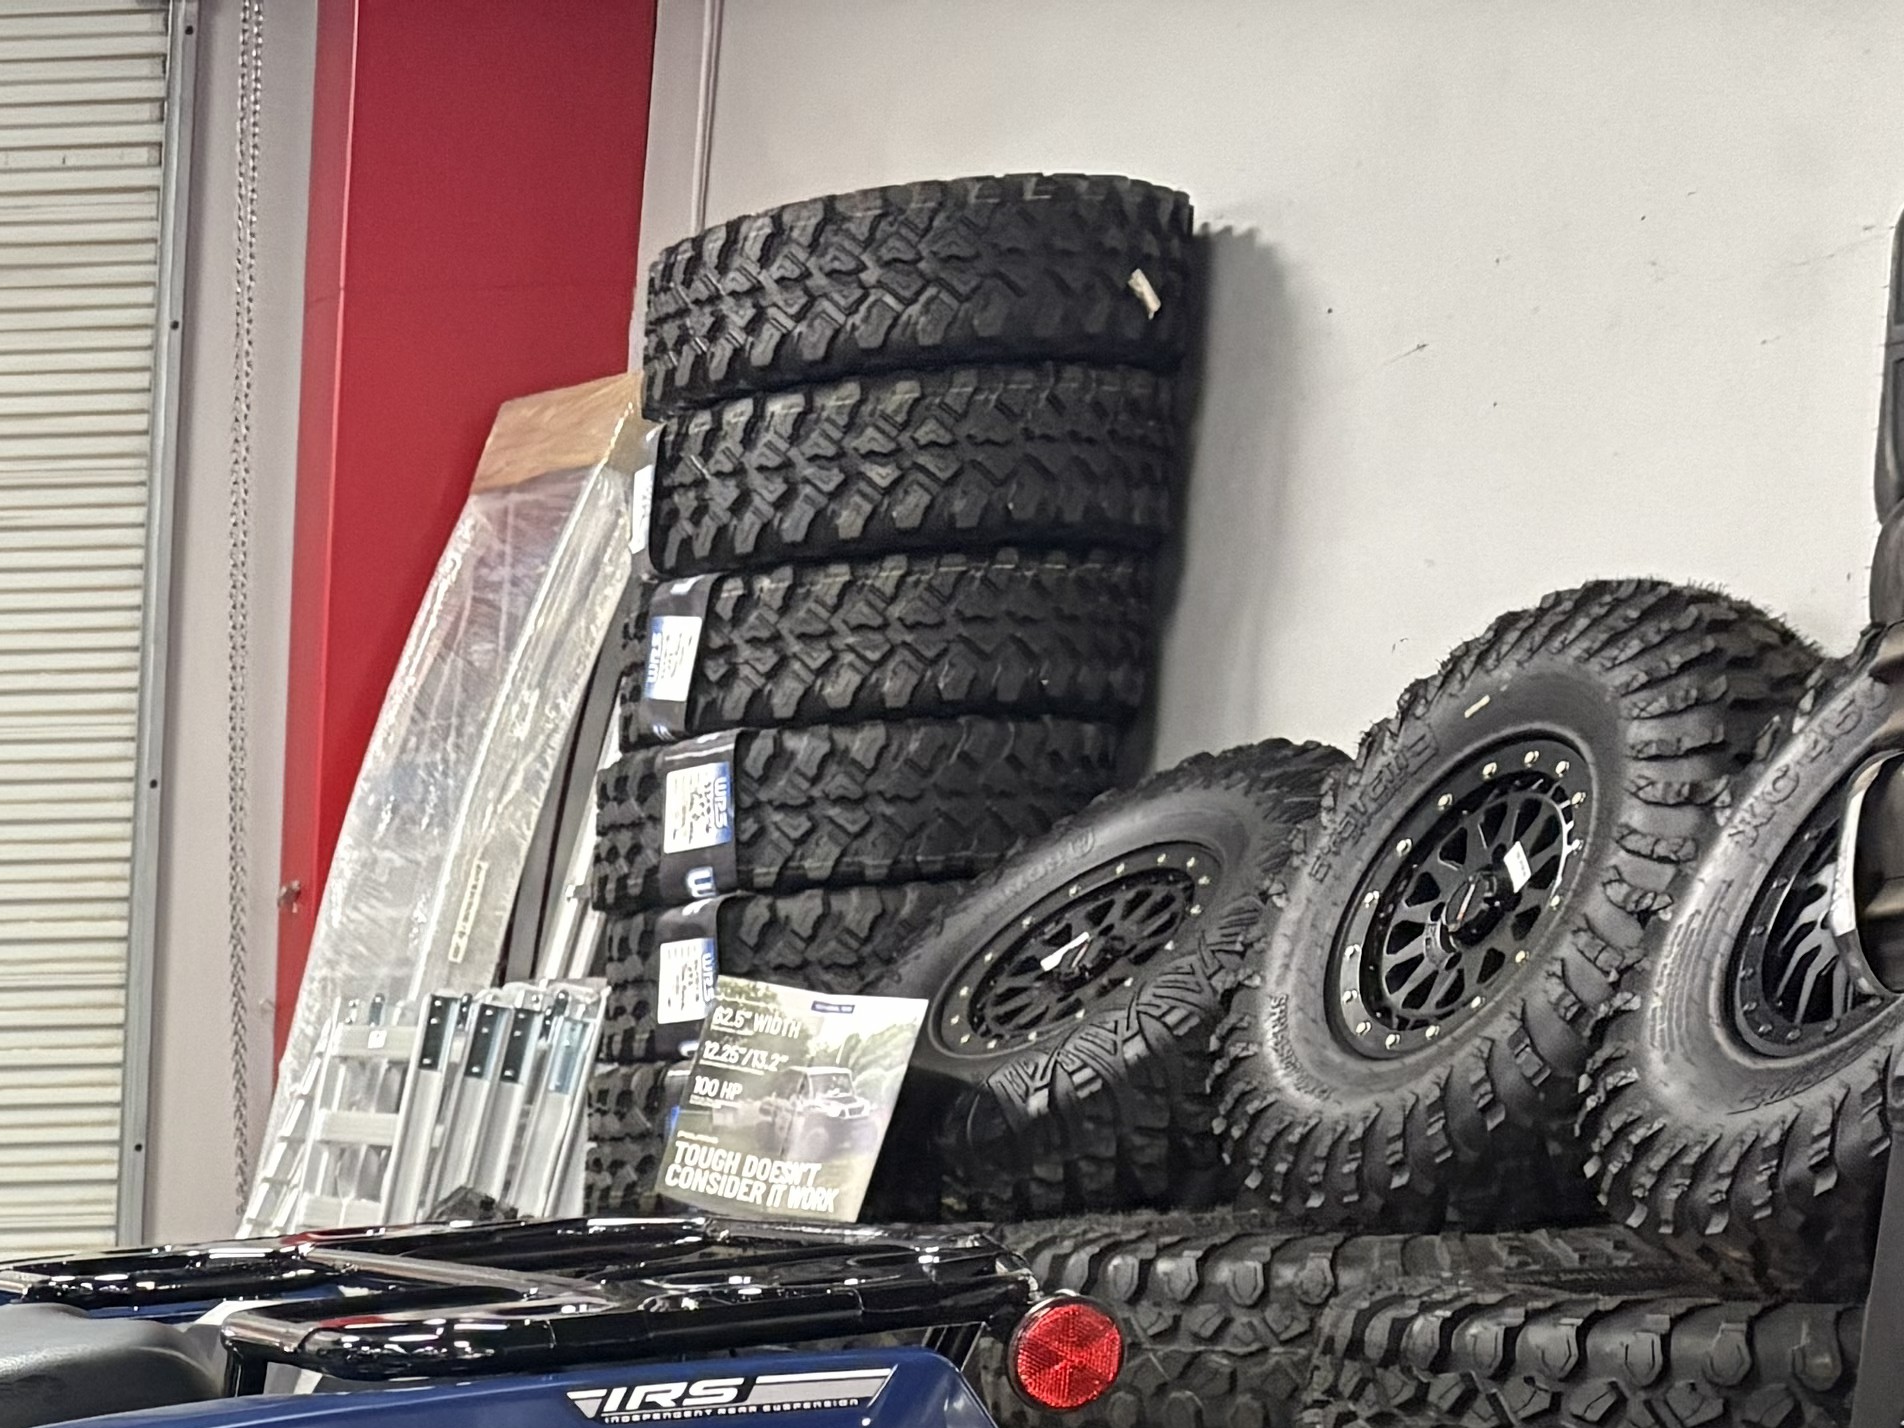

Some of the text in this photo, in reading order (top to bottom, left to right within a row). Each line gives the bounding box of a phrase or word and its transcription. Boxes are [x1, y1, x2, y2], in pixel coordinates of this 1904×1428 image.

[753, 1011, 802, 1039] WIDTH
[694, 1075, 743, 1100] 100 HP
[673, 1140, 822, 1187] TOUGH DOESN'T
[665, 1164, 840, 1213] CONSIDER IT WORK
[602, 1377, 745, 1411] IRS
[604, 1398, 859, 1424] INDEPENDENT REAR SUSPENSION
